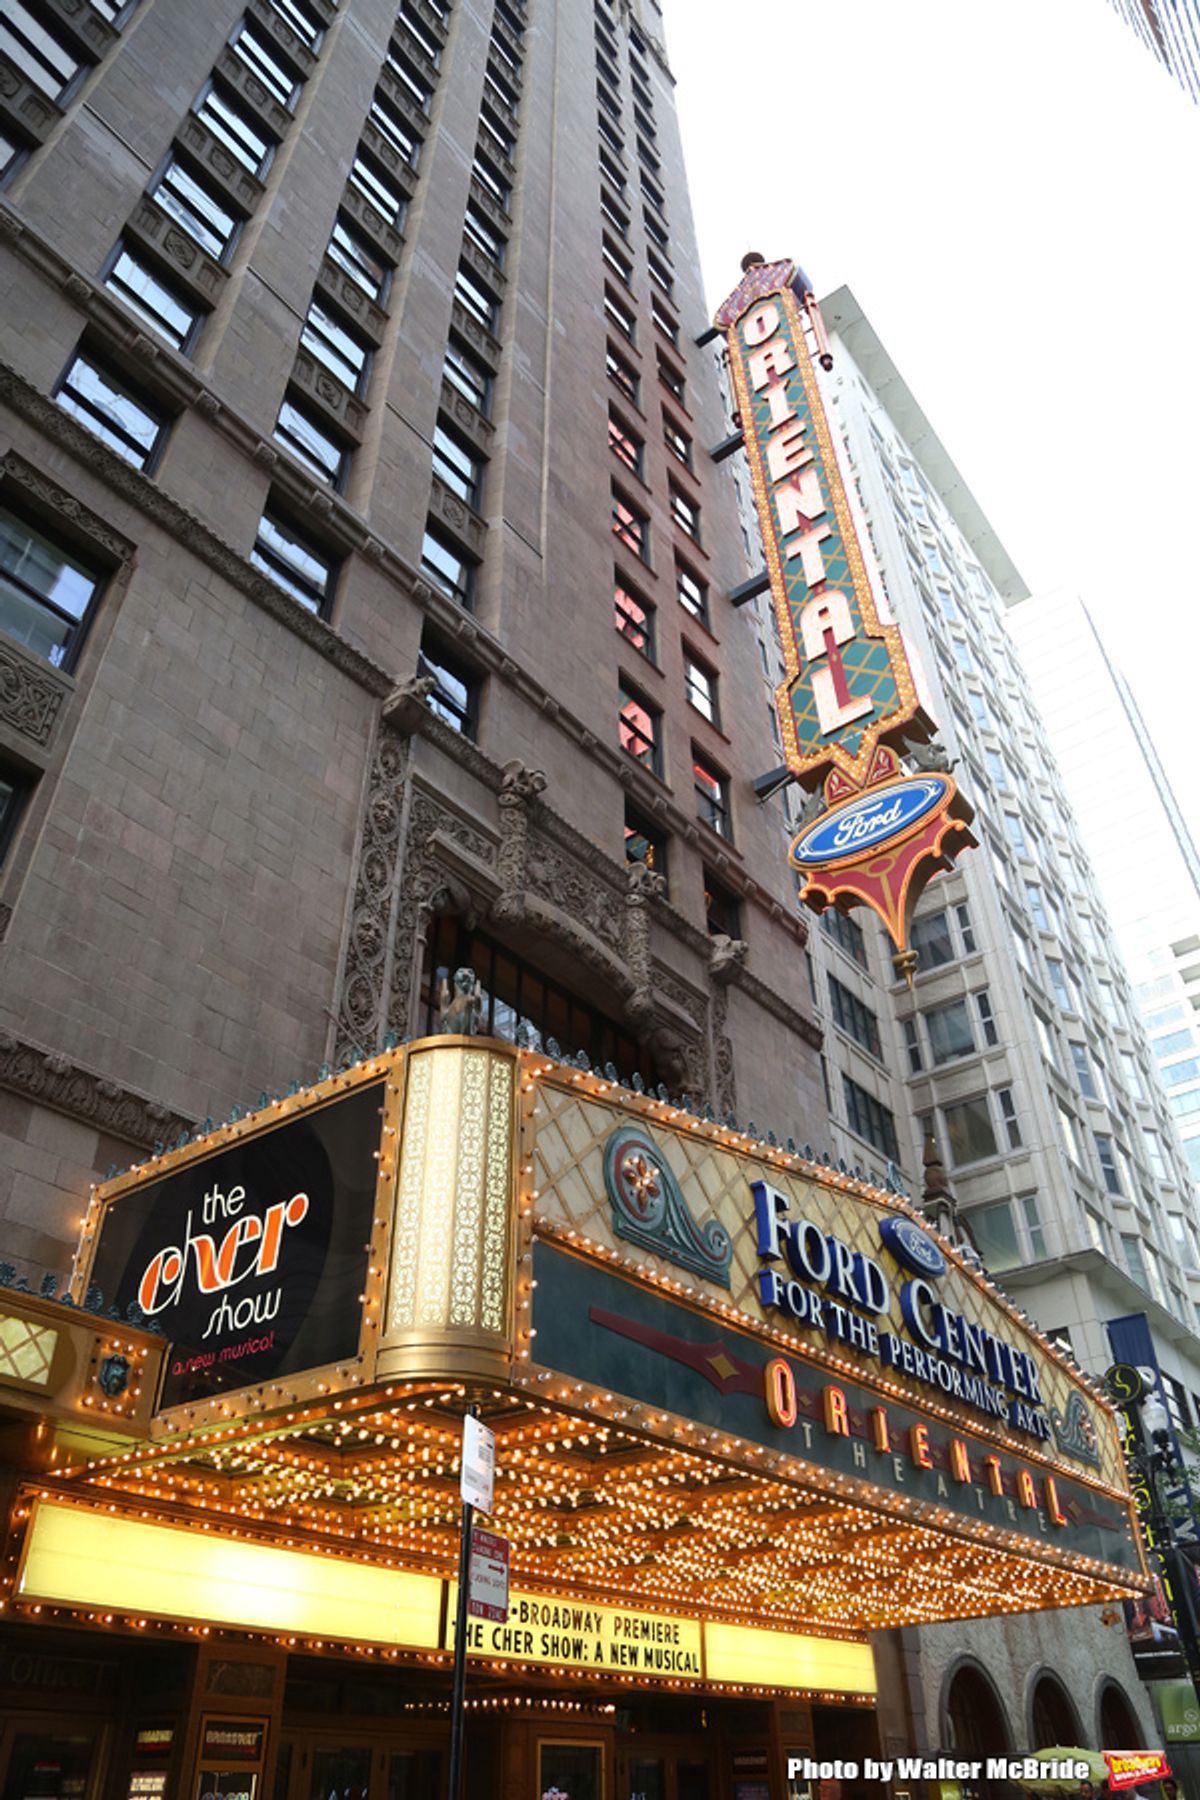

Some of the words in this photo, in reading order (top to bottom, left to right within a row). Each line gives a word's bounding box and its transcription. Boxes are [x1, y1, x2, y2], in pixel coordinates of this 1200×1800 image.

[743, 303, 874, 736] ORIENTAL
[834, 799, 902, 846] Ford
[202, 1183, 246, 1224] the
[138, 1192, 309, 1315] cher
[909, 1231, 932, 1264] Ford
[202, 1288, 282, 1340] show
[752, 1180, 890, 1315] FORD
[902, 1278, 1043, 1404] CENTER
[184, 1352, 216, 1373] new
[218, 1330, 276, 1362] musical
[761, 1269, 825, 1329] FOR
[829, 1301, 880, 1357] THE
[883, 1332, 1009, 1421] PERFORMING
[1011, 1402, 1051, 1441] ARTS
[765, 1356, 1068, 1527] ORIENTAL
[801, 1421, 1047, 1533] THEATRE
[492, 1627, 534, 1655] CHER
[541, 1633, 589, 1662] SHOW:
[594, 1641, 604, 1663] A
[610, 1643, 638, 1667] NEW
[644, 1645, 700, 1674] MUSICAL
[613, 1615, 680, 1645] PREMIERE
[1168, 1723, 1197, 1737] argo
